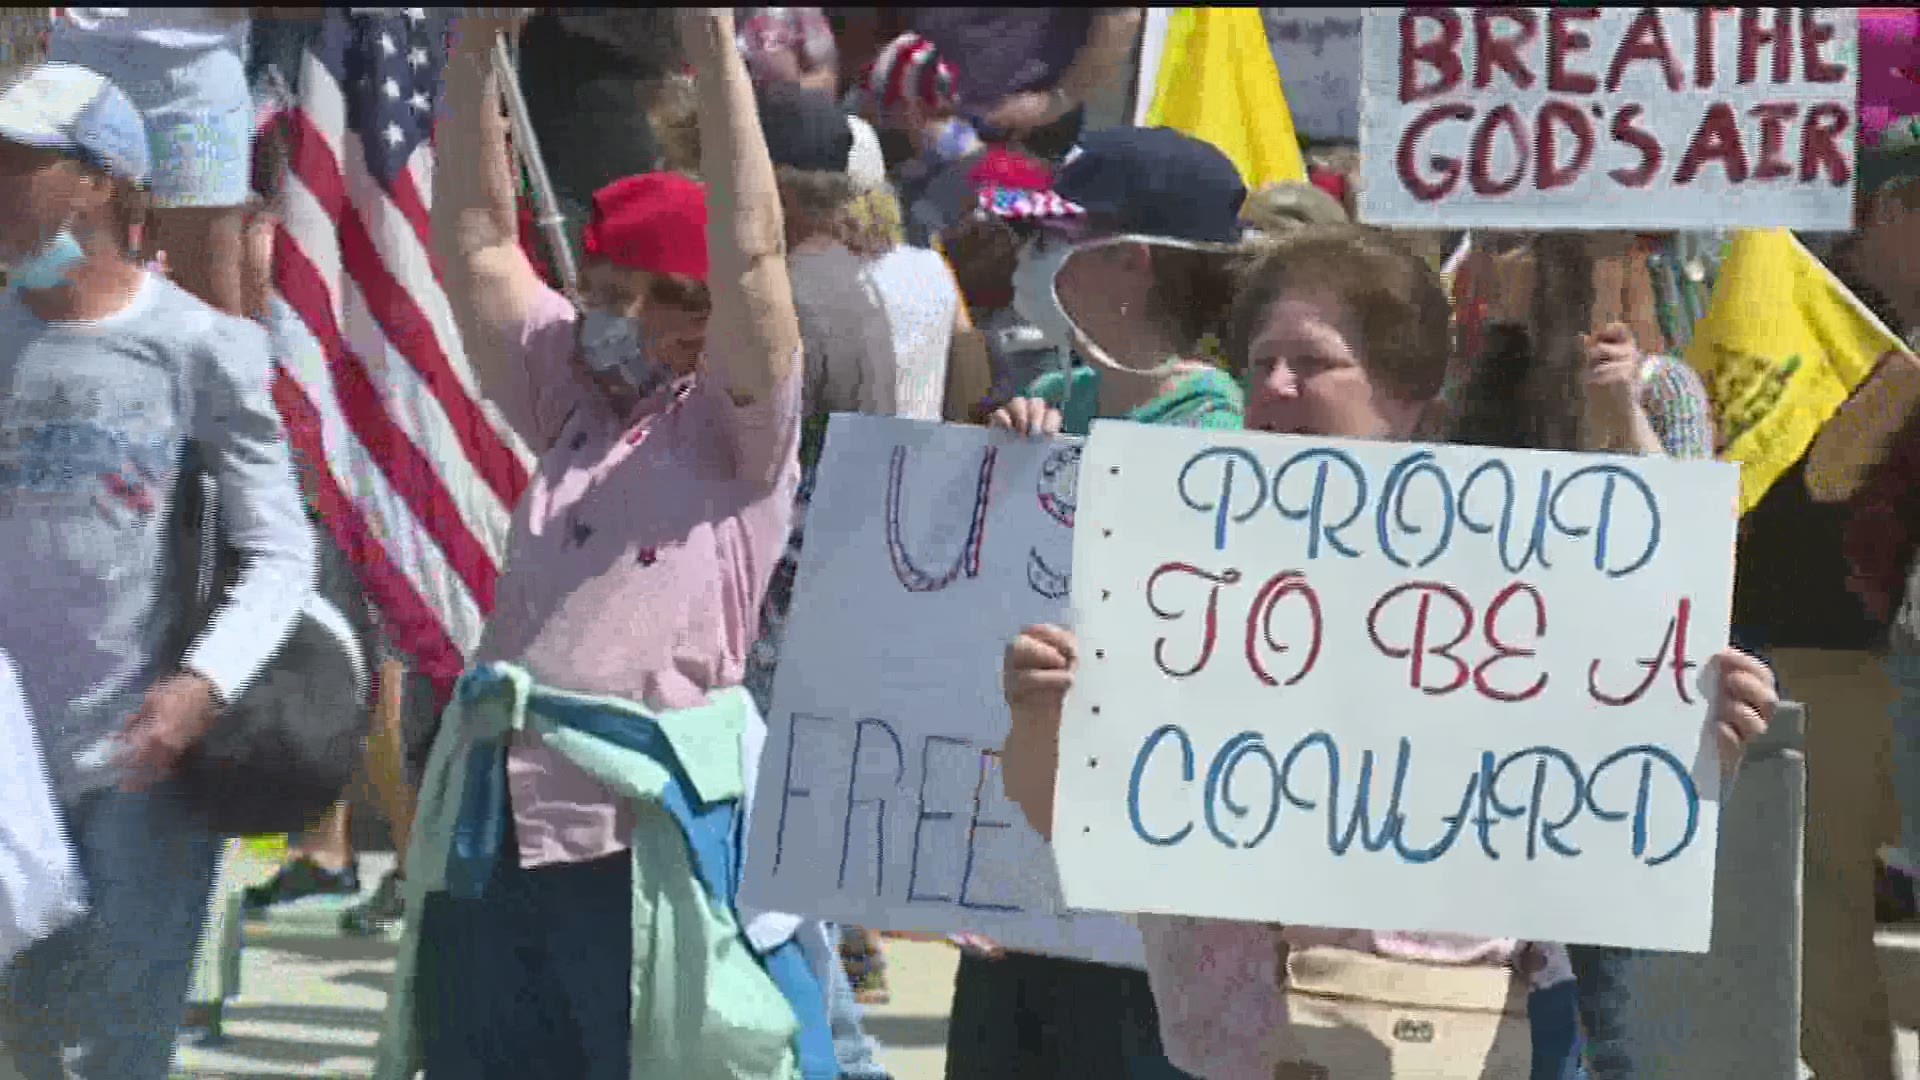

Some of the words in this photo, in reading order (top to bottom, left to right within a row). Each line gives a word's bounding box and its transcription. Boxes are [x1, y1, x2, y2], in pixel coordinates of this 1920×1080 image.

[1399, 8, 1847, 103] BREATHE
[1396, 101, 1664, 202] GOD'S
[1672, 101, 1851, 187] AIR
[1178, 446, 1661, 578] PROUD
[1146, 562, 1323, 687] TO
[1366, 580, 1549, 702] BE
[1588, 596, 1697, 706] A
[1127, 722, 1700, 866] COWARD
